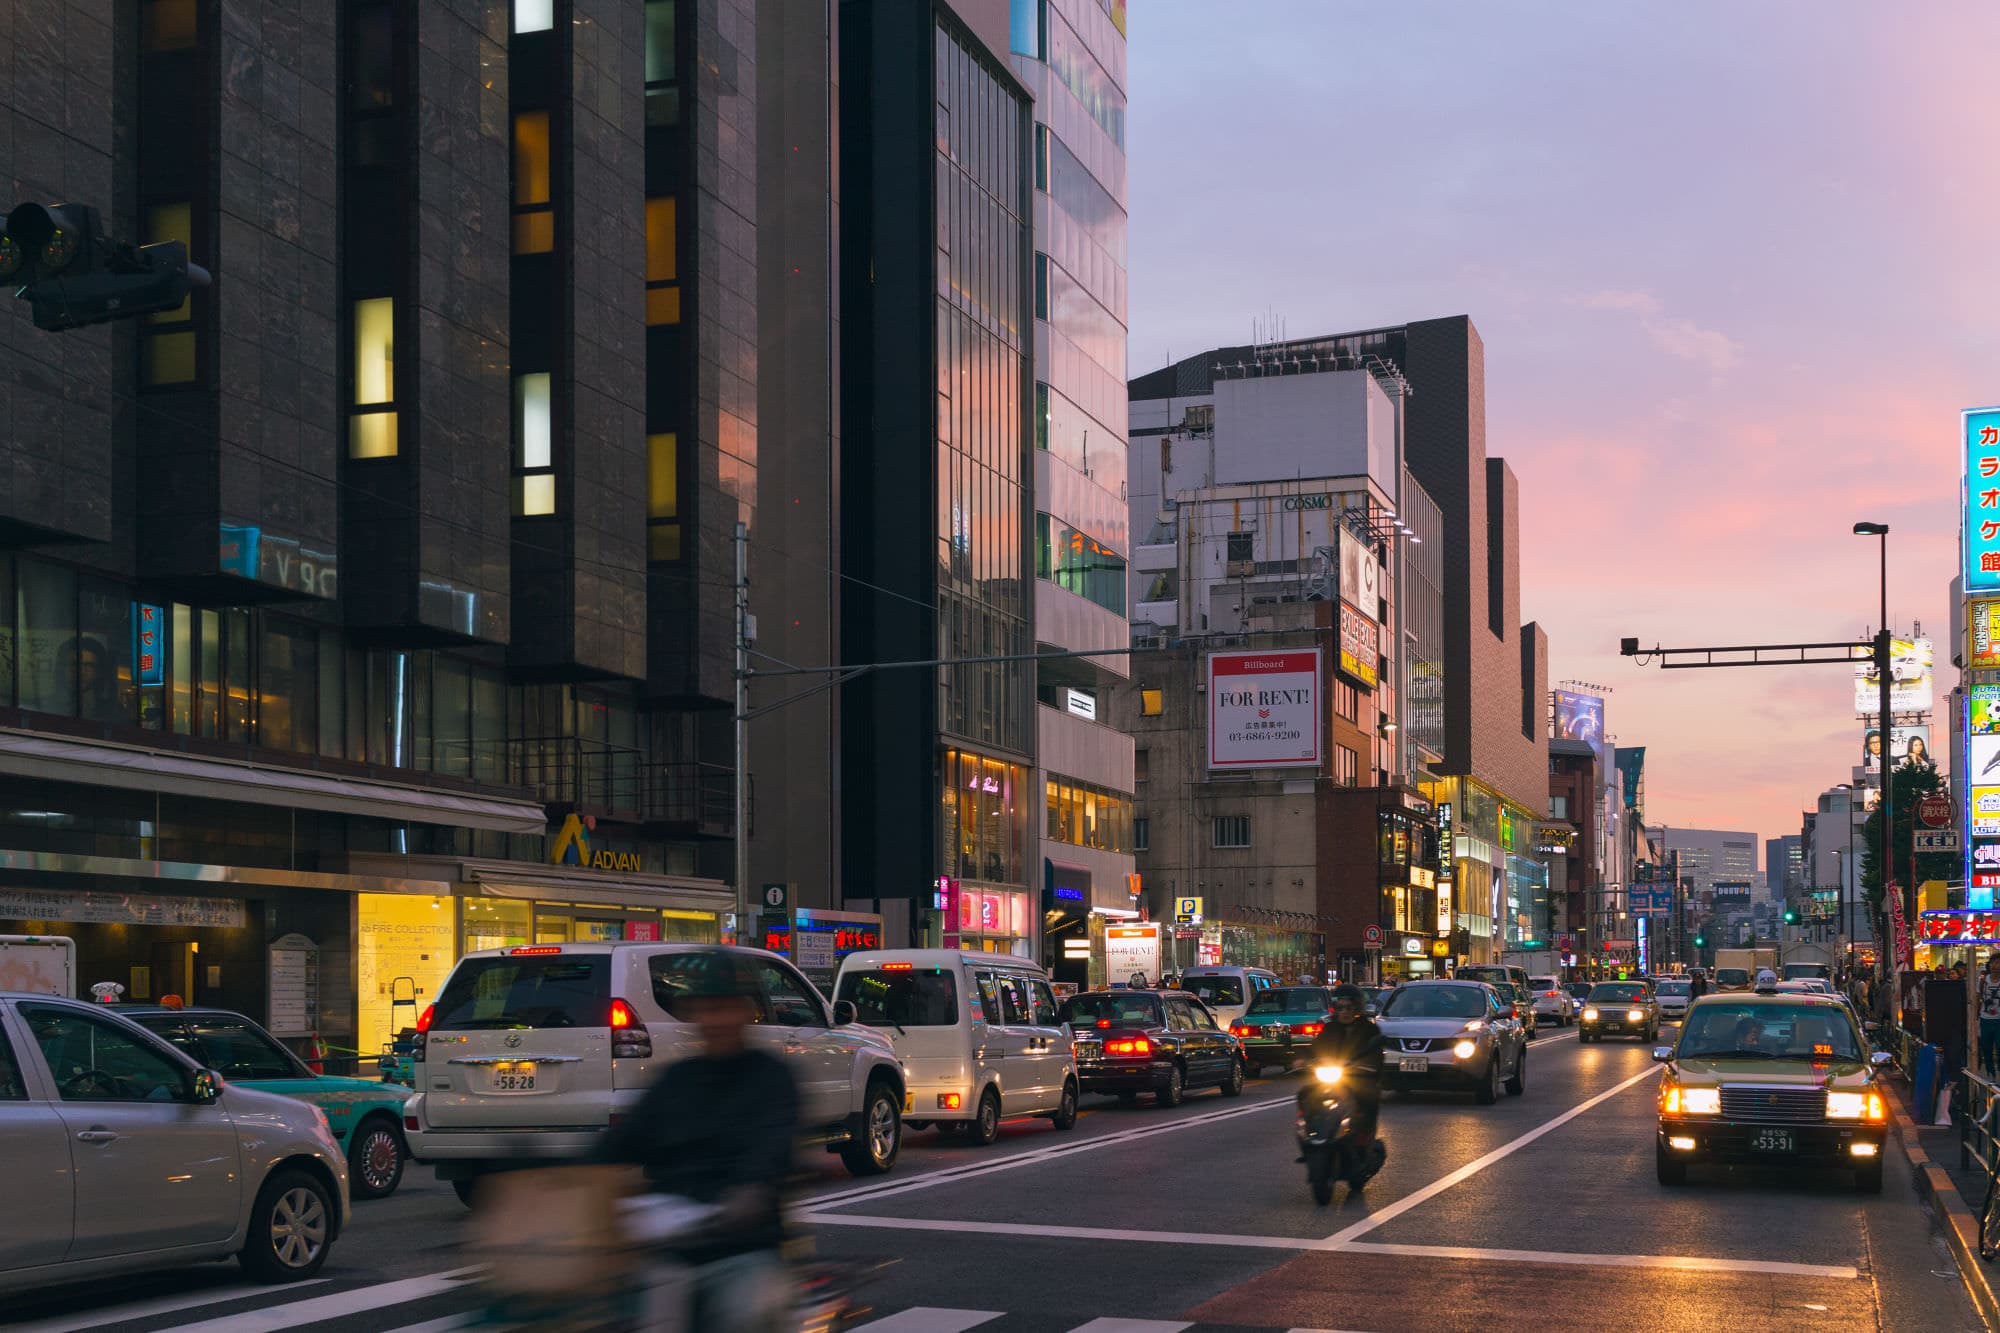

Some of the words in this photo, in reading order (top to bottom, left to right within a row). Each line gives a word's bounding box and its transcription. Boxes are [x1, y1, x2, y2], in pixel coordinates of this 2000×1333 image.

[1284, 496, 1332, 511] COSMO
[1980, 426, 2000, 572] カラオケ館
[1244, 660, 1284, 669] Billboard
[1220, 691, 1254, 707] FOR
[1259, 689, 1309, 706] RENT!
[1229, 730, 1301, 742] 03-6864-9200
[1919, 836, 1956, 847] KEN
[592, 849, 641, 873] ADVAN
[500, 1076, 535, 1090] 58-28
